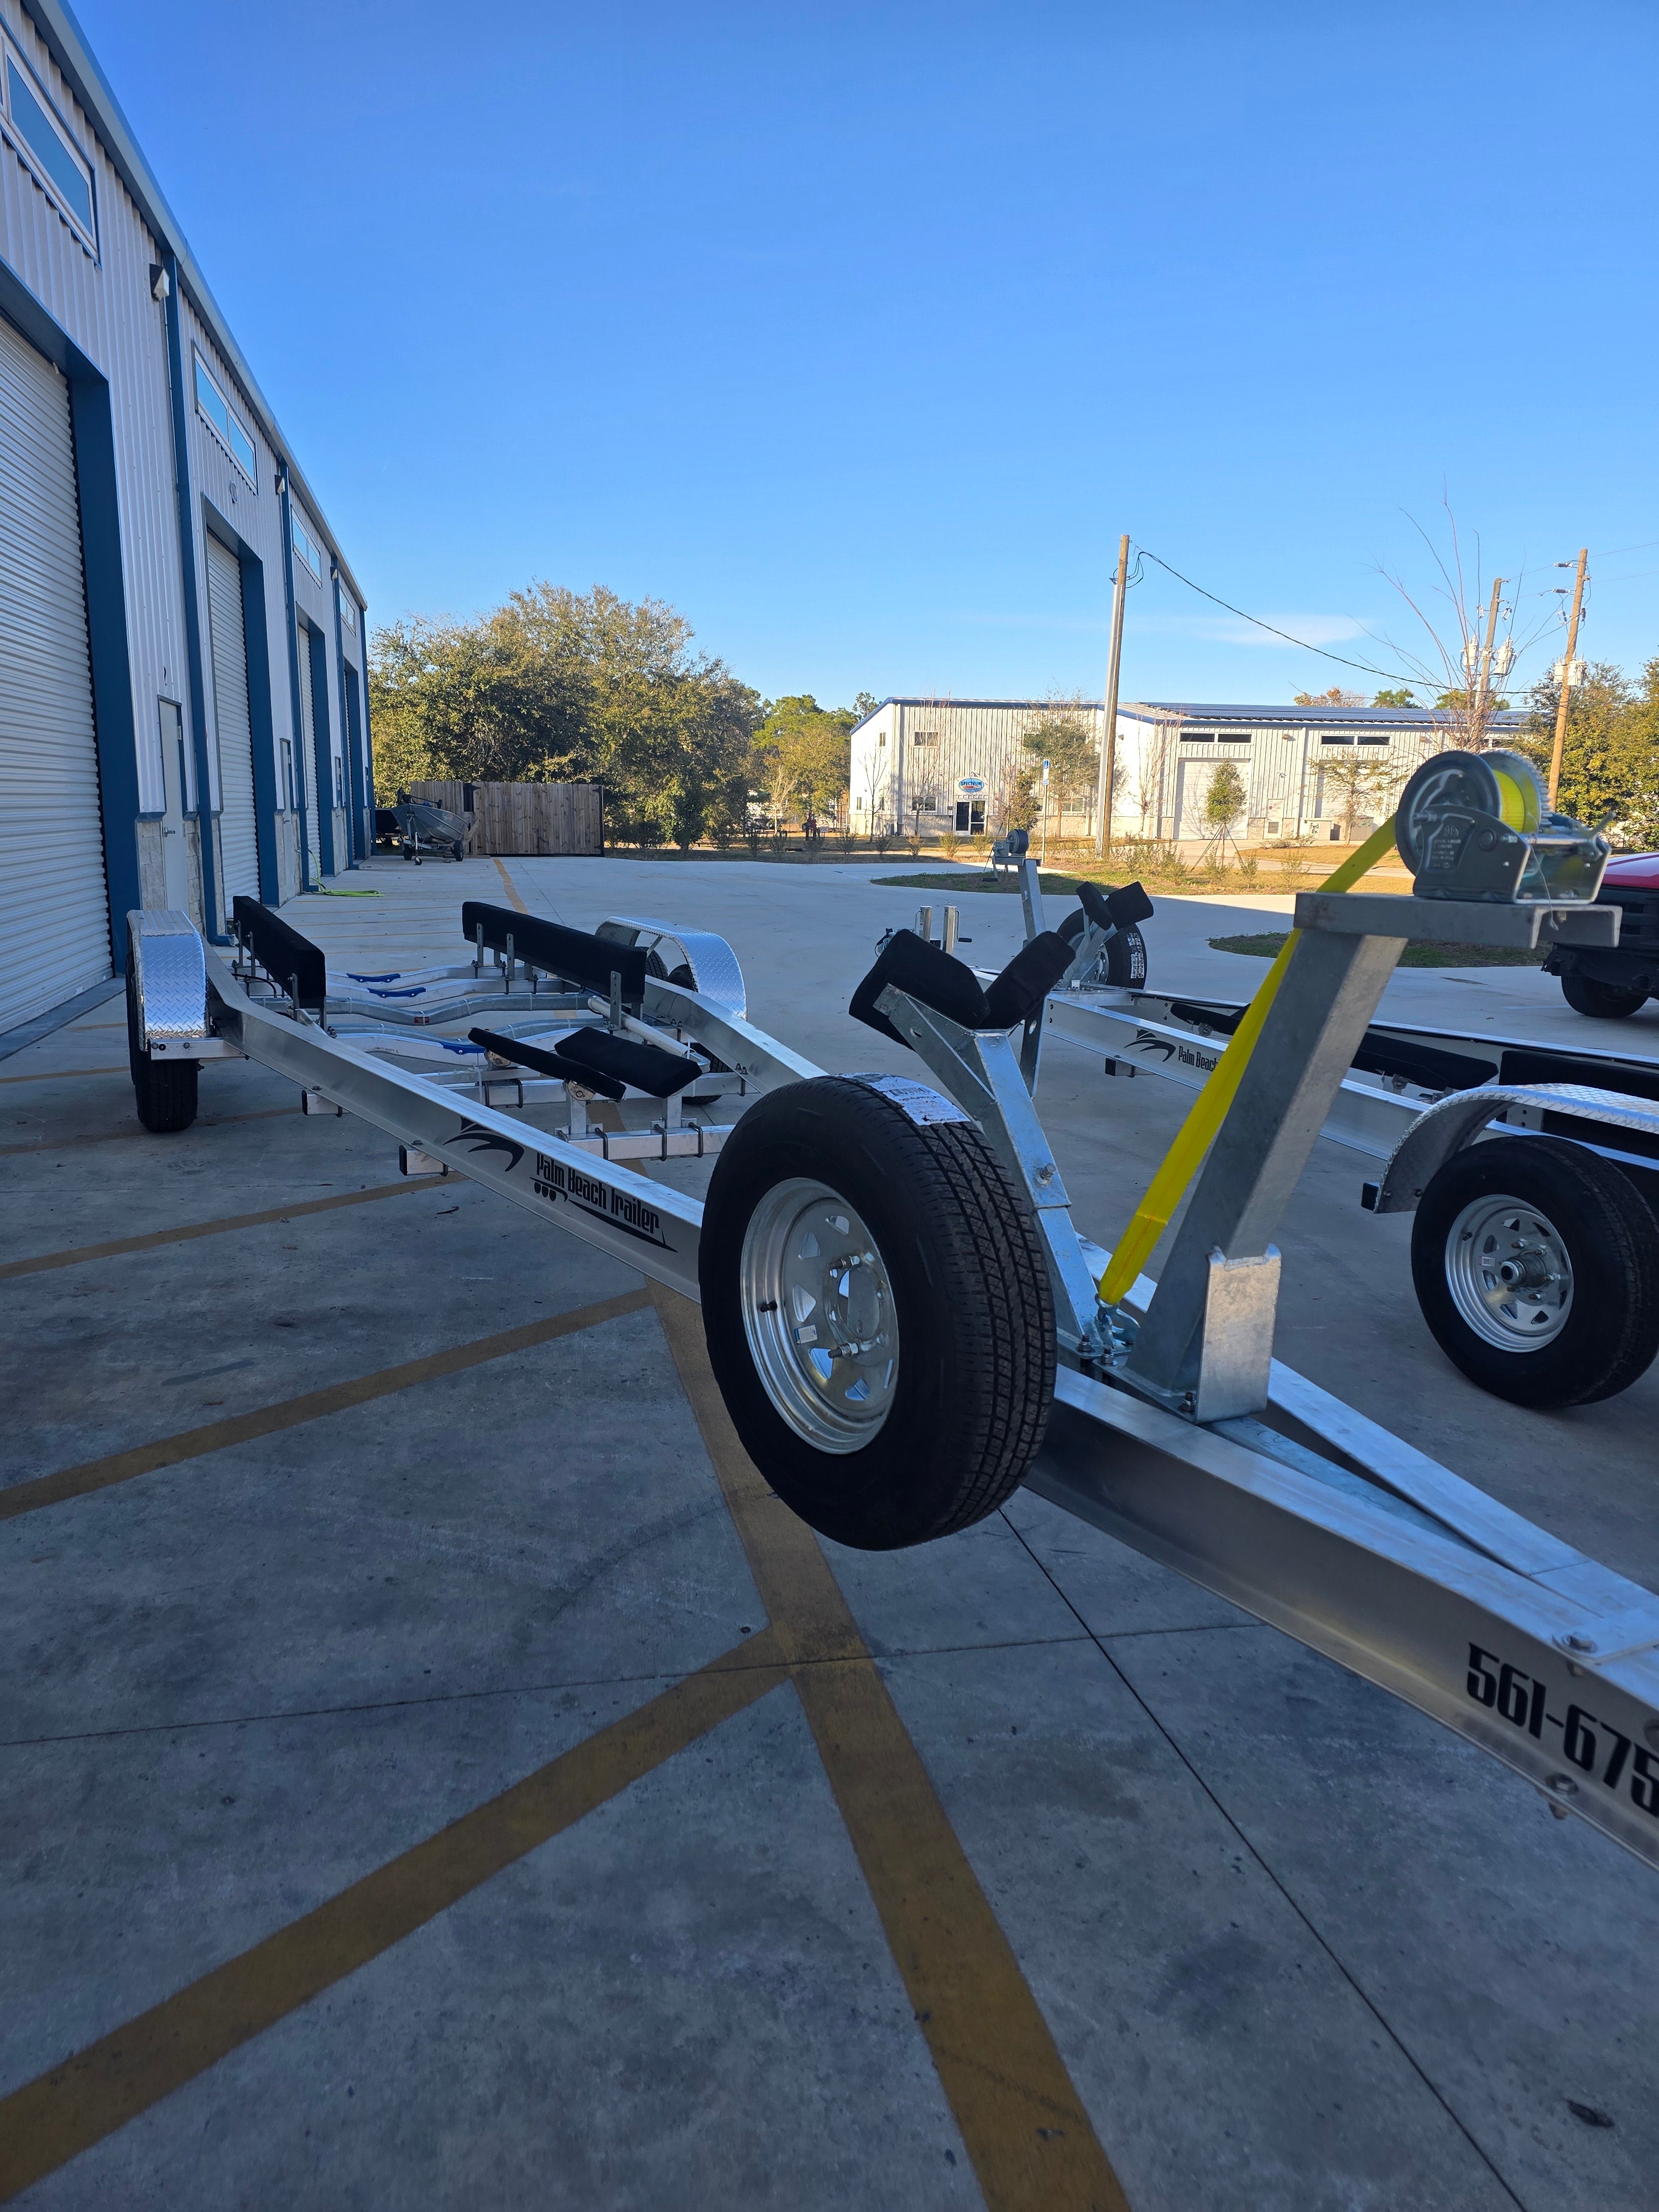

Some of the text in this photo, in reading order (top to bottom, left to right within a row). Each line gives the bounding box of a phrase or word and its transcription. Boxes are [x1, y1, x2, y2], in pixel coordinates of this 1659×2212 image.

[1178, 1046, 1218, 1072] Palm Beach
[536, 1152, 659, 1234] Palm Beach Trailer
[1467, 1641, 1659, 1818] 561-675
